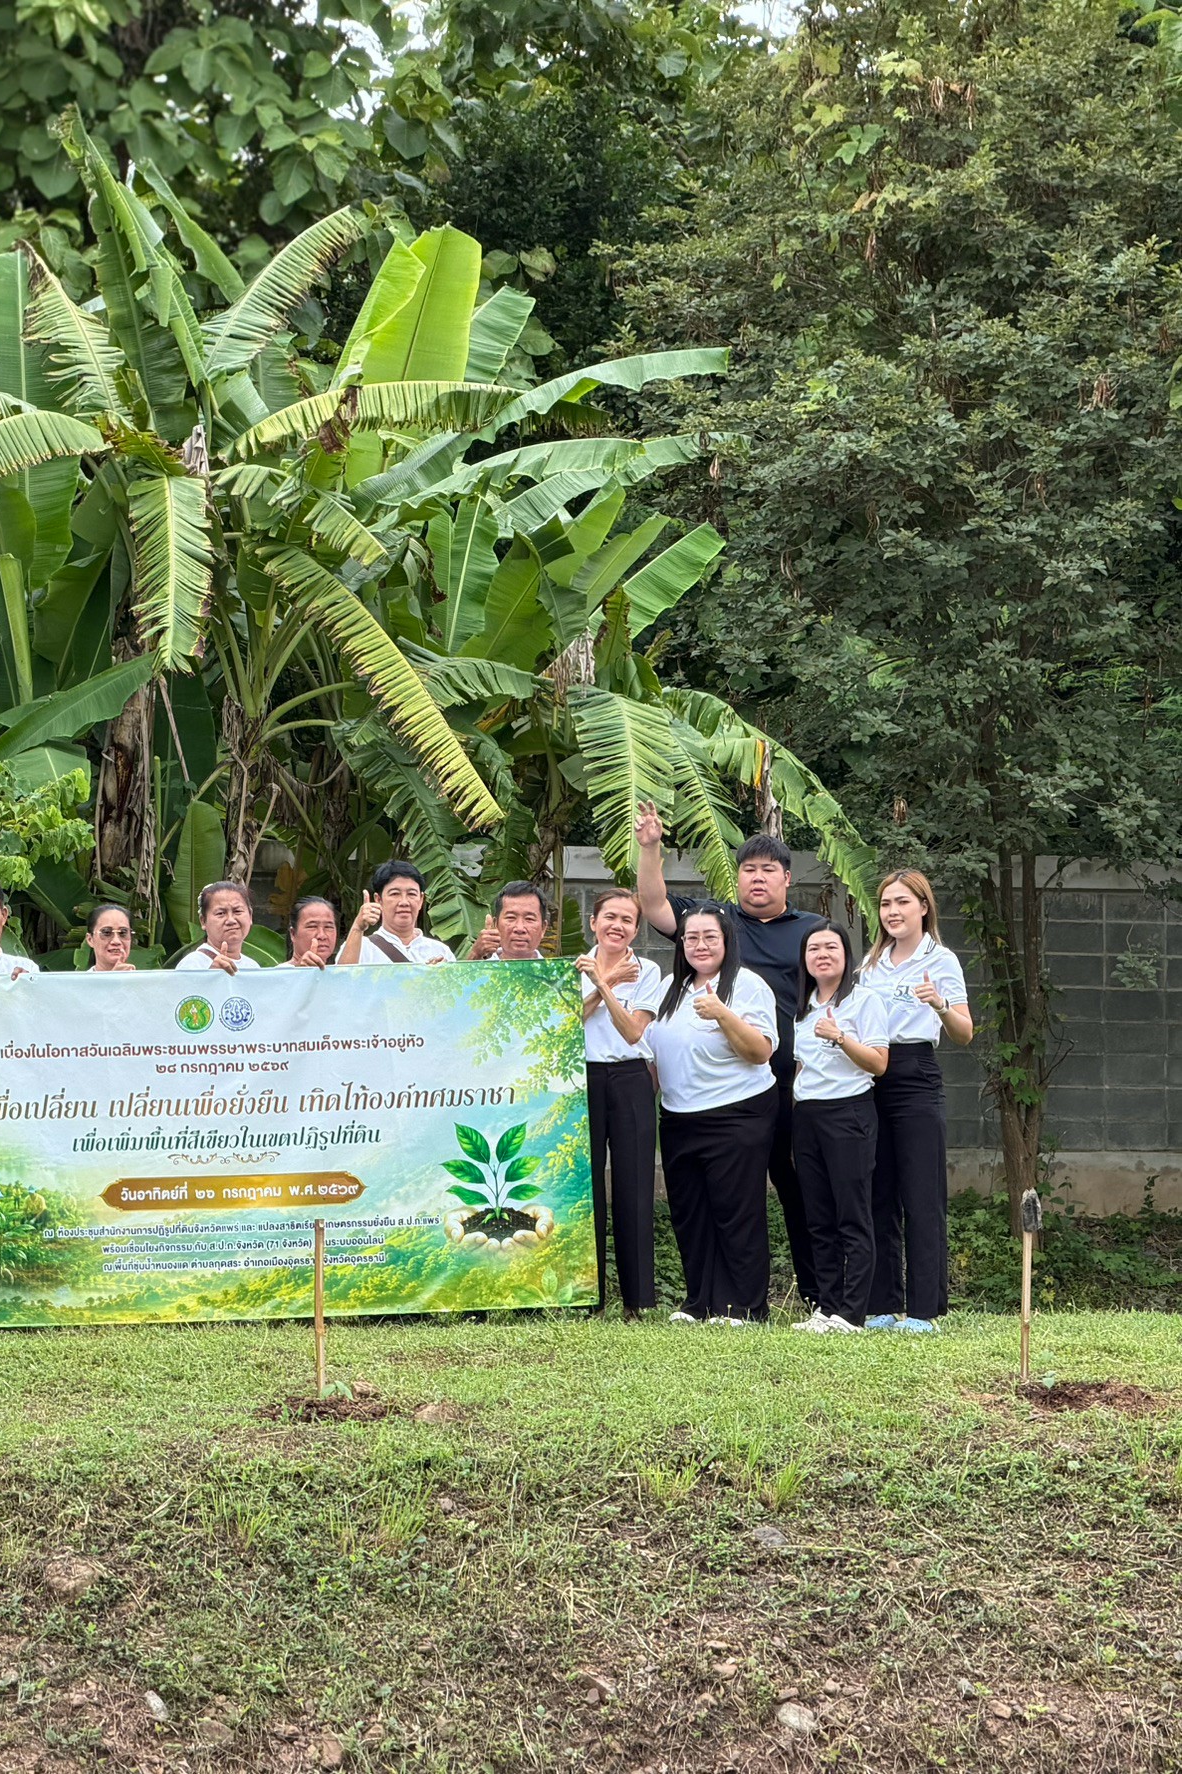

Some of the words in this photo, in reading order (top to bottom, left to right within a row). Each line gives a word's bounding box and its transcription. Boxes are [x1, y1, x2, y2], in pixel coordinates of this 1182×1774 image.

[0, 1034, 425, 1059] เนื่องในโอกาสวันเฉลิมพระชนมพรรษาพระบาทสมเด็จพระเจ้าอยู่หัว
[155, 1063, 177, 1074] ๒๘
[180, 1061, 245, 1076] กรกฎาคม
[248, 1060, 290, 1072] ๒๕๖๙
[108, 1083, 290, 1119] เปลี่ยนเพื่อยั่งยืน
[298, 1081, 516, 1113] เทิดไท้องค์ทศมราชา
[72, 1120, 382, 1152] เพื่อเพิ่มพื้นที่สีเขียวในเขตปฏิรูปที่ดิน
[120, 1181, 189, 1202] วันอาทิตย์ที่
[194, 1189, 215, 1200] ๒๖
[222, 1186, 282, 1201] กรกฎาคม
[288, 1183, 360, 1198] พ.ศ.๒๕๖๙
[44, 1229, 54, 1238] ณ
[58, 1222, 239, 1240] ห้องประชุมสำนักงานการปฏิรูปที่ดินจังหวัดแพร่
[241, 1224, 255, 1232] และ
[397, 1214, 440, 1226] ส.ป.ก.แพร่
[103, 1241, 193, 1254] พร้อมเชื่อมโยงกิจกรรม
[194, 1241, 207, 1252] กับ
[266, 1240, 279, 1251] (71
[282, 1238, 312, 1249] จังหวัด)
[103, 1263, 113, 1272] ณ
[243, 1256, 316, 1270] อำเภอเมืองอุดรธา
[324, 1252, 385, 1266] จังหวัดอุดรธานี
